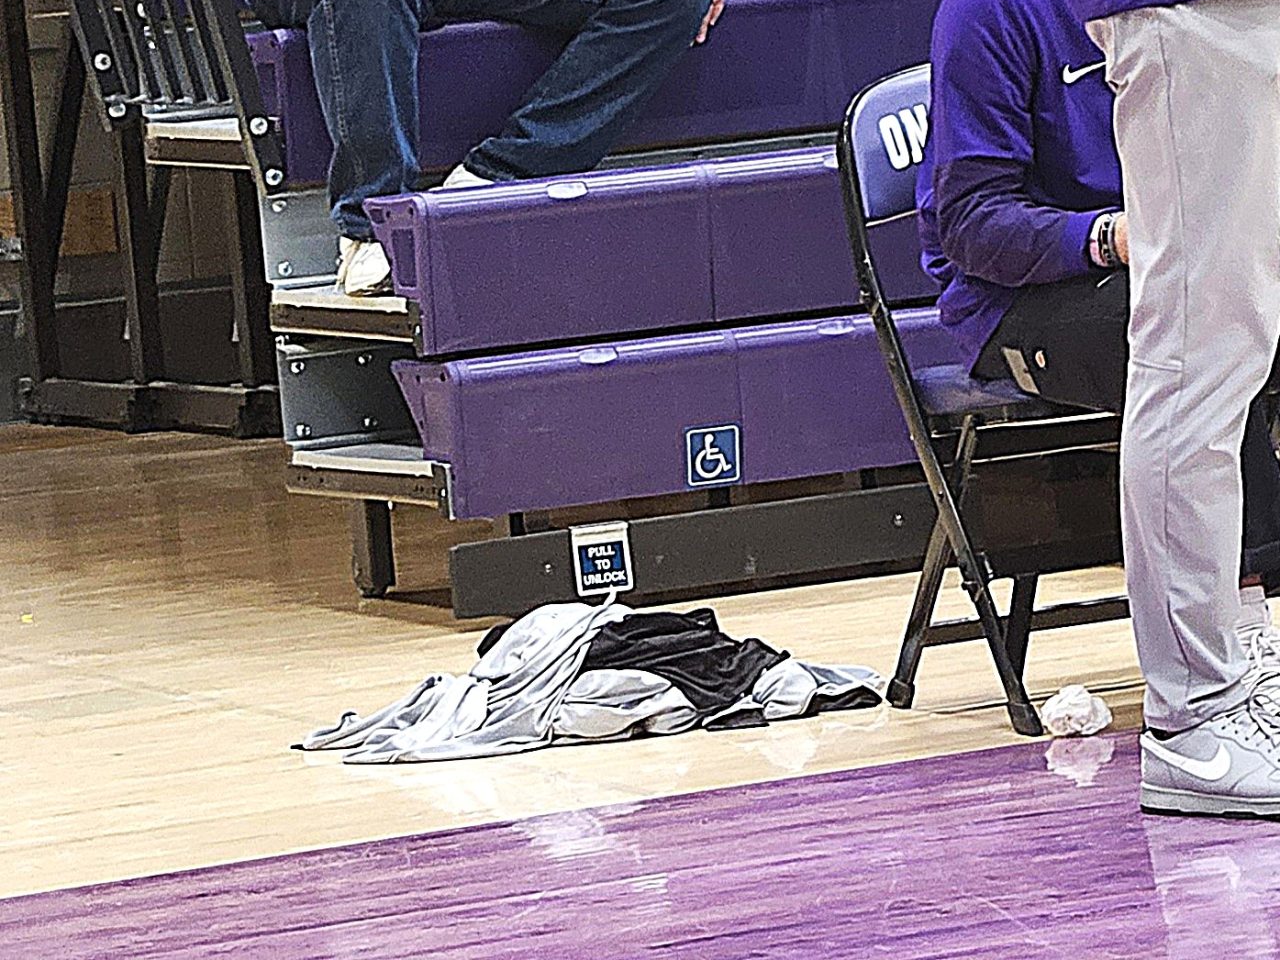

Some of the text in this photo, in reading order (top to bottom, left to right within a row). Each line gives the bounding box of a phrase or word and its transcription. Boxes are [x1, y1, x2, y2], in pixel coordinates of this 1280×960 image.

[587, 544, 615, 558] PULL
[595, 558, 611, 570] TO
[583, 570, 627, 586] UNLOCK
